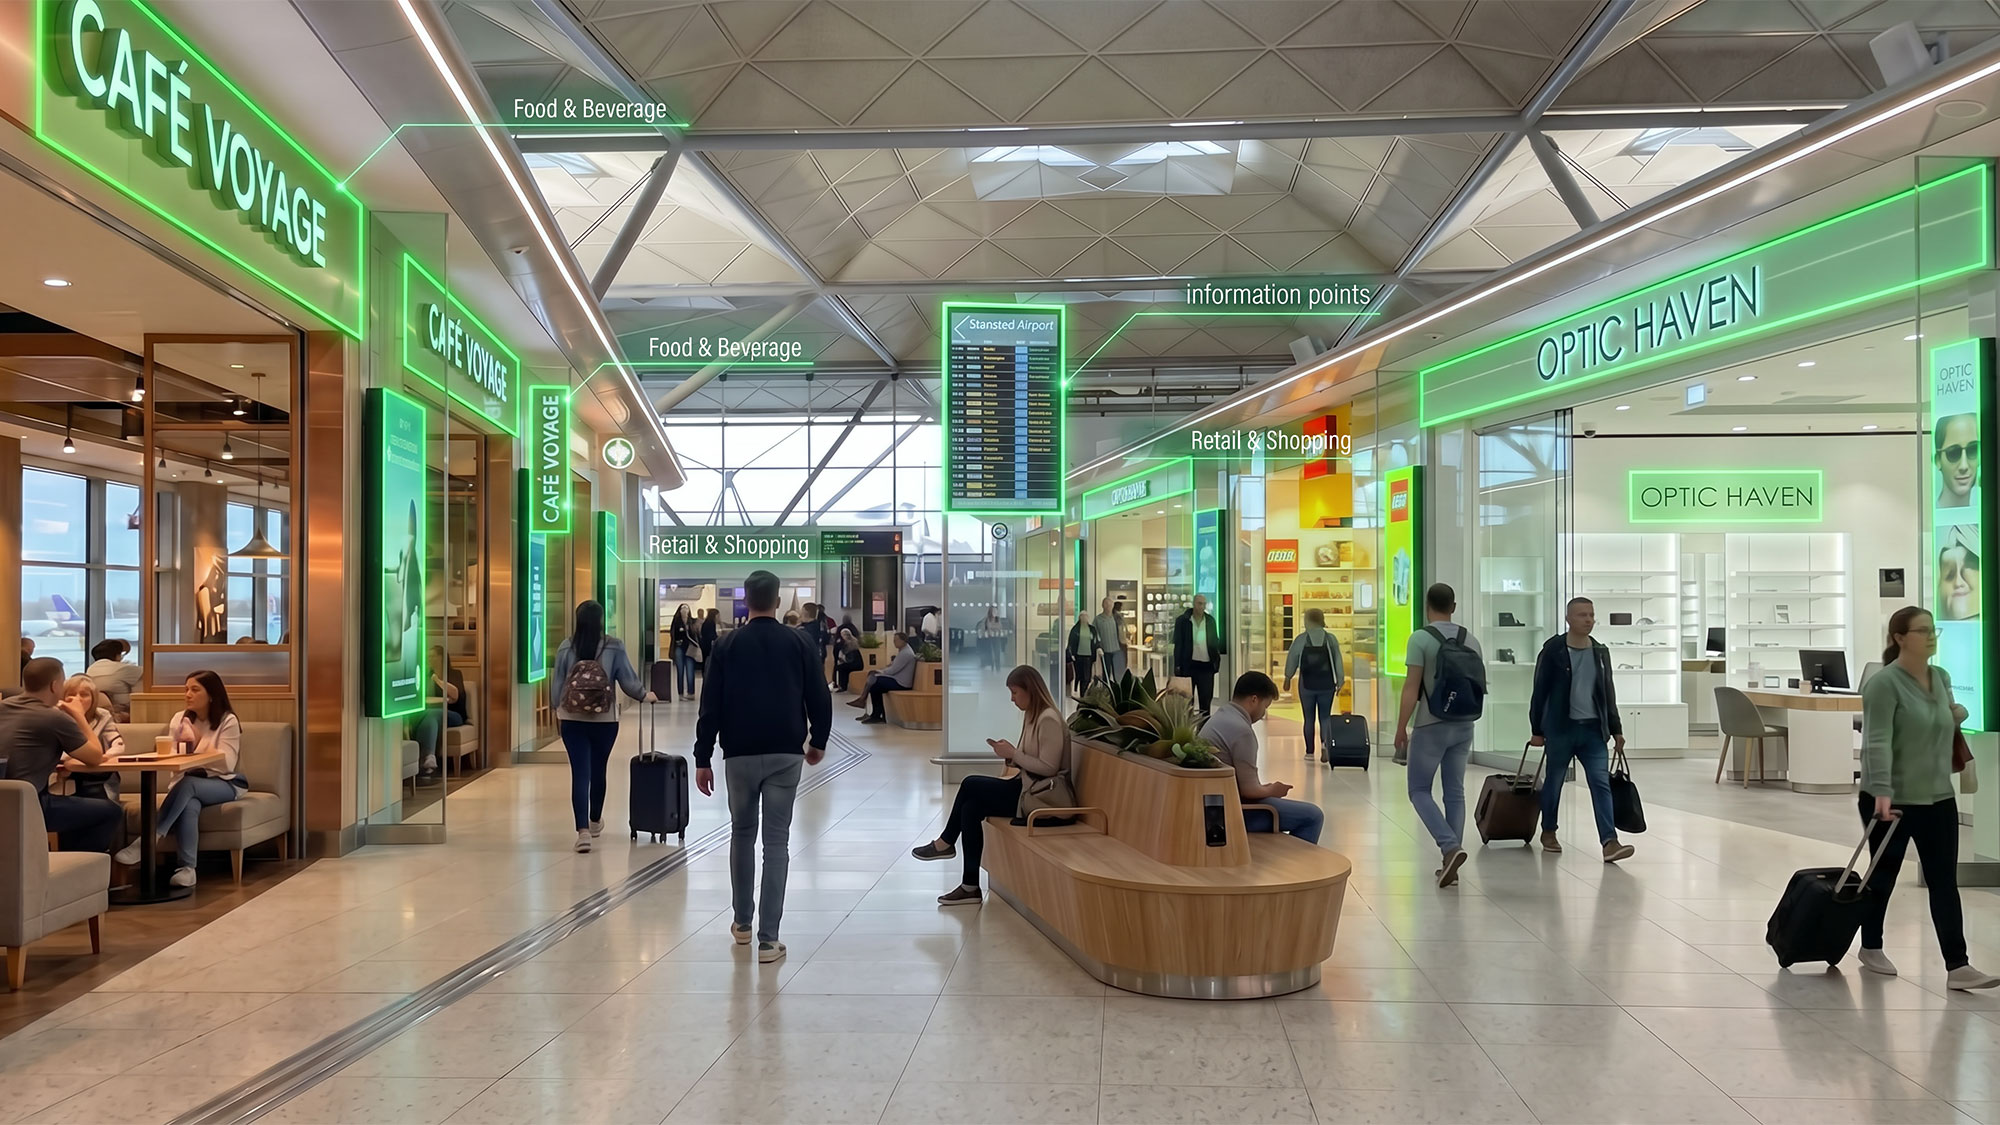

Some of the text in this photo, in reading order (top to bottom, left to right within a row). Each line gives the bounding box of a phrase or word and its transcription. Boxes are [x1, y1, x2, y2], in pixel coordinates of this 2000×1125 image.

[71, 0, 326, 269] CAFÉ VOYAGE
[969, 318, 1054, 333] Stansted Airport
[1537, 265, 1760, 381] OPTIC HAVEN
[429, 303, 508, 403] CAFÉ VOYAGE
[1940, 363, 1972, 381] OPTIC
[1936, 379, 1975, 396] HAVEN
[542, 395, 560, 470] VOYAGE
[1641, 486, 1813, 508] OPTIC HAVEN
